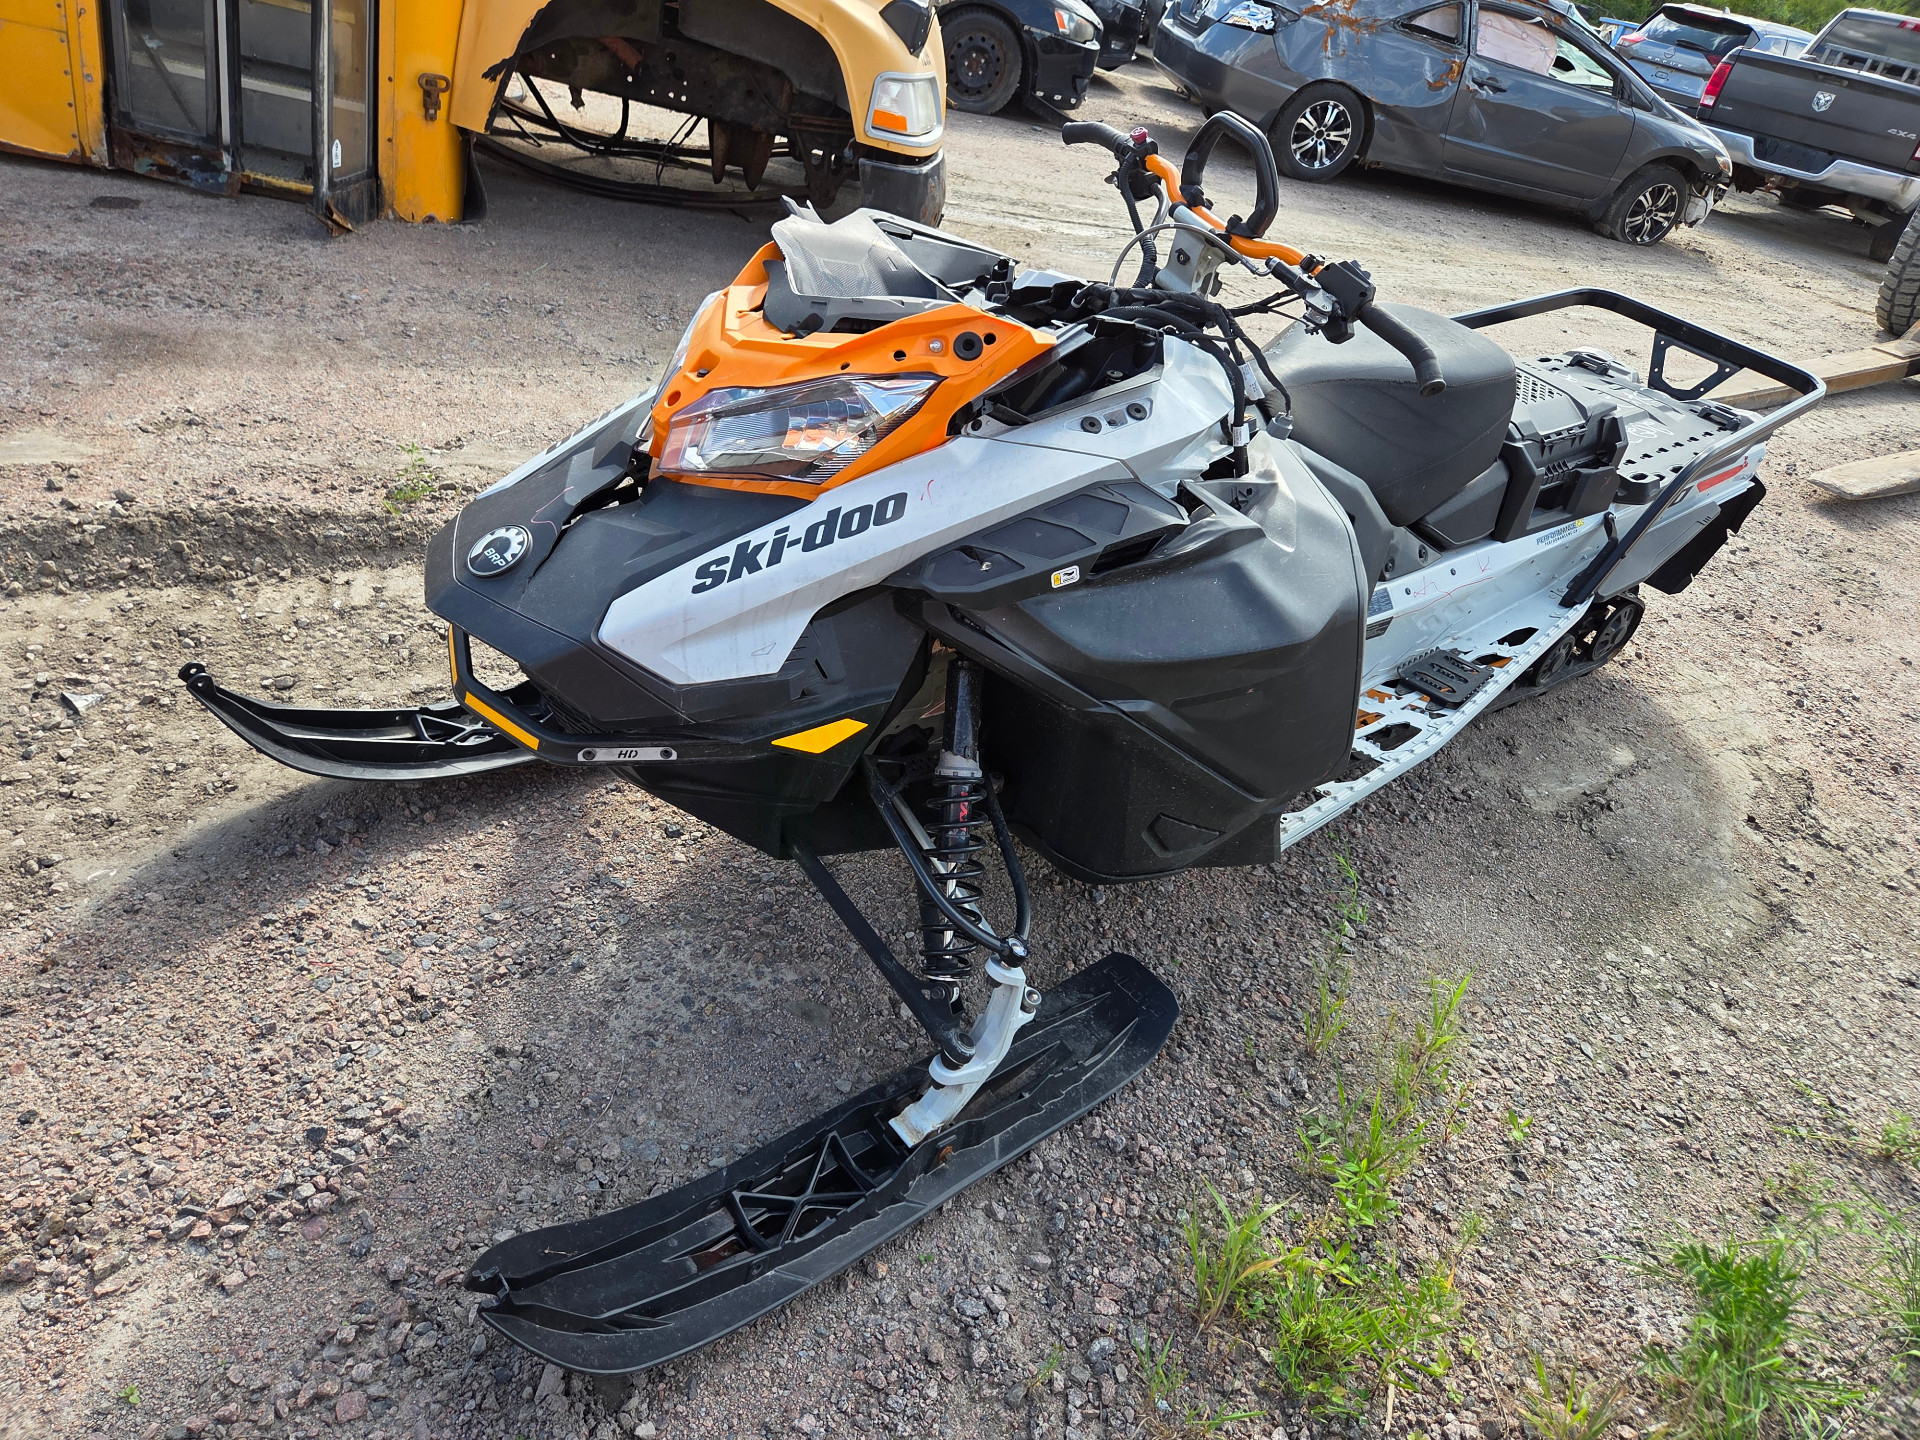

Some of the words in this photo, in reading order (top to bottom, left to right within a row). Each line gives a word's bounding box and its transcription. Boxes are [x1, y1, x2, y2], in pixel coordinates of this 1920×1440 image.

[691, 492, 908, 594] ski-doo
[483, 547, 506, 567] BRP
[617, 749, 639, 760] HD
